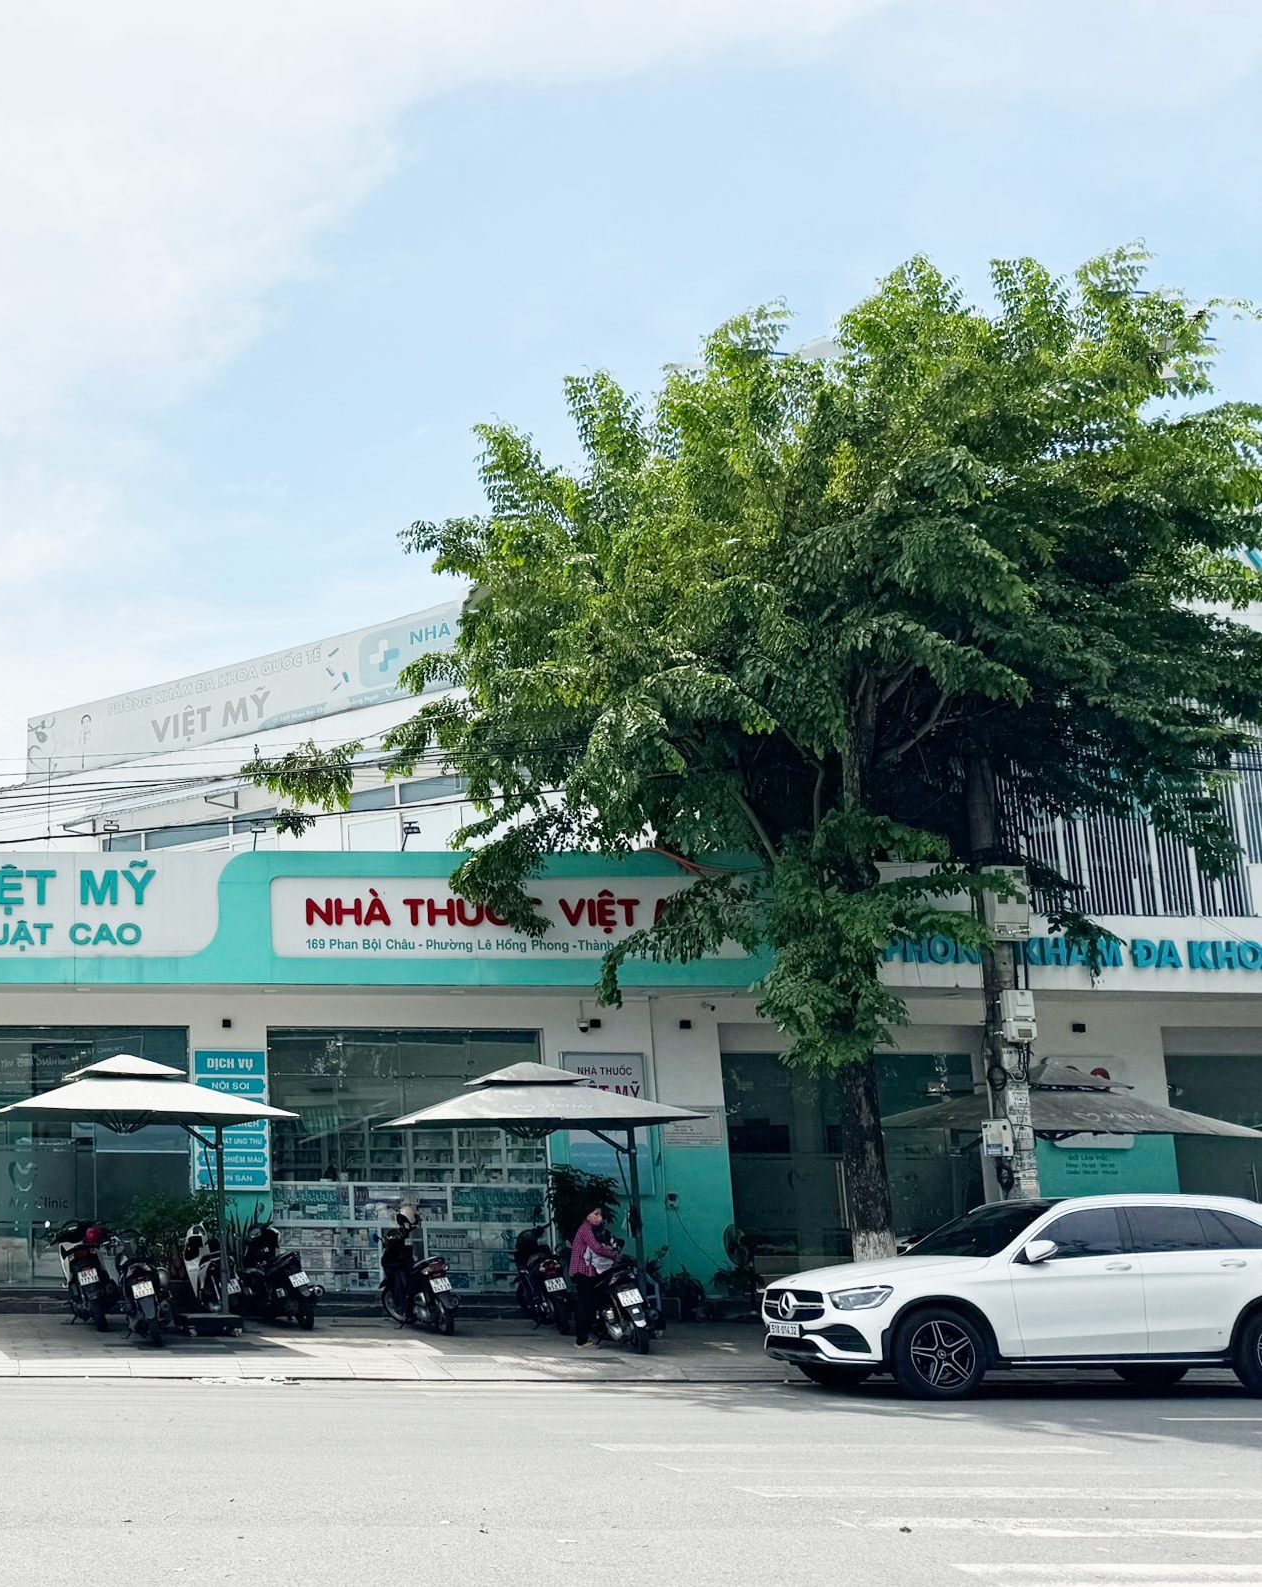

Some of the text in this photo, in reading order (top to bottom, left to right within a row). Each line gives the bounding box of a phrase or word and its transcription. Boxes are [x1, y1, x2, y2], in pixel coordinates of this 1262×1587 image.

[410, 619, 451, 645] NHÀ
[107, 643, 322, 716] PHÒNG KHÁM ĐA KHOA QUỐC TẾ
[151, 686, 271, 742] VIỆT MỸ
[80, 860, 156, 905] MỸ
[305, 887, 391, 927] NHÀ
[402, 898, 542, 928] THU
[558, 889, 640, 934] VIỆT
[69, 922, 142, 946] CAO
[306, 939, 325, 950] 169
[329, 939, 358, 950] Phan
[362, 938, 381, 952] Bội
[386, 938, 415, 950] Châu
[426, 939, 473, 953] Phường
[478, 939, 492, 950] Lê
[496, 938, 527, 953] Hồng
[532, 940, 569, 953] Phong
[1130, 938, 1183, 968] ĐA
[206, 1058, 253, 1072] DỊCH VỤ
[578, 1064, 632, 1076] NHÀ THUỐC
[212, 1081, 250, 1092] NỘI SOI
[615, 1081, 640, 1098] MỸ
